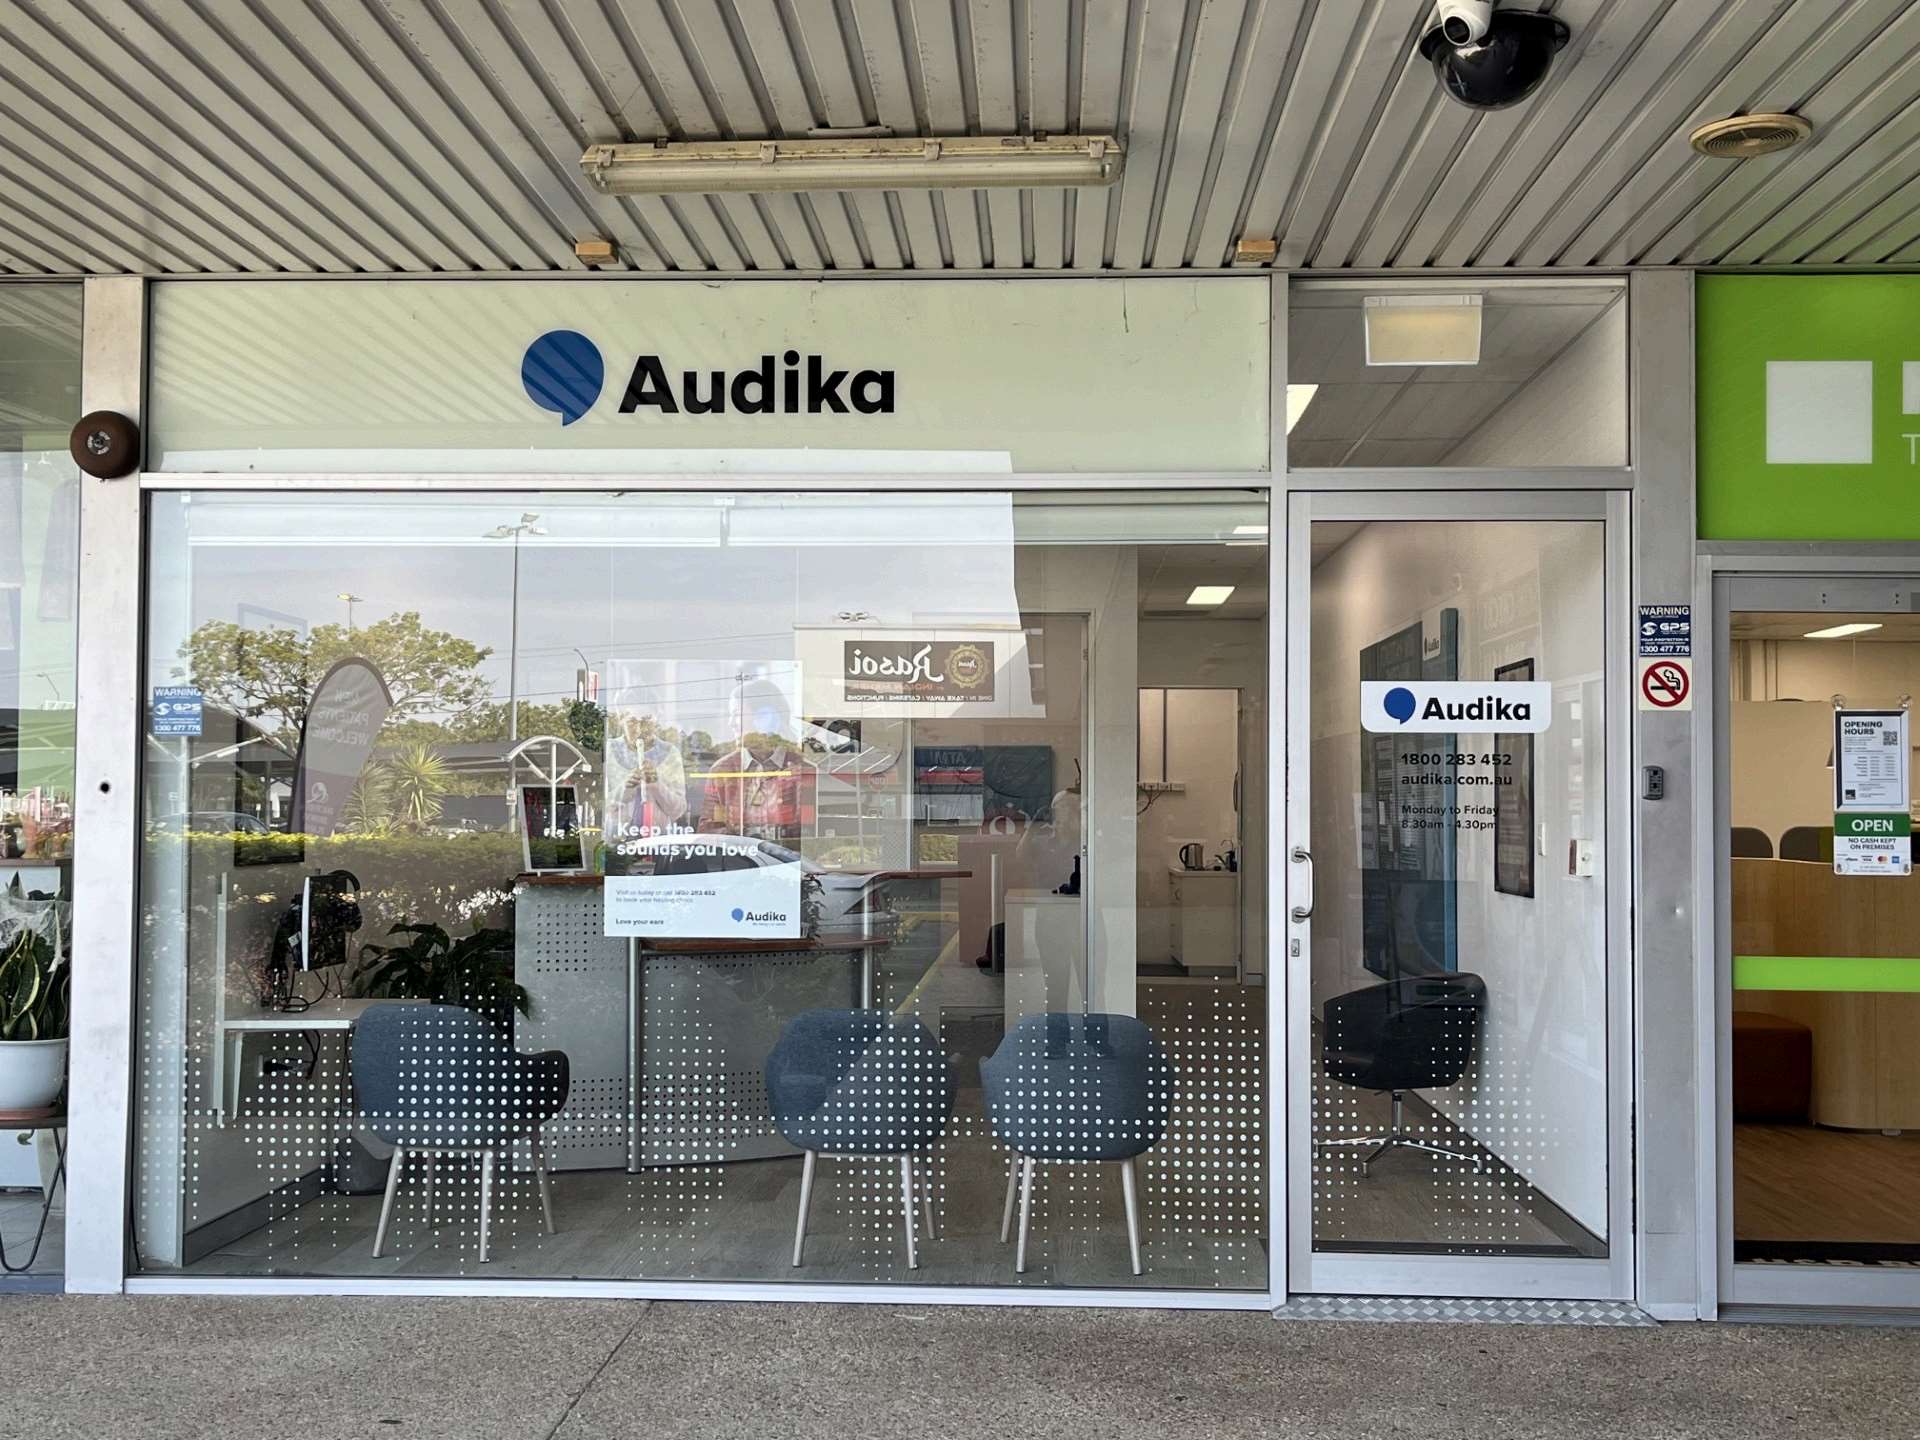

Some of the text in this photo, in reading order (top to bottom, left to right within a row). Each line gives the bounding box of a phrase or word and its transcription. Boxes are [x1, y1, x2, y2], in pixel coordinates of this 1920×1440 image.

[618, 350, 895, 415] Audika
[1640, 606, 1689, 616] WARNING
[1660, 622, 1690, 631] GPS
[155, 687, 201, 696] WARNING
[173, 703, 201, 711] GPS
[1422, 695, 1531, 720] Audika
[1401, 753, 1512, 766] 1800 283 452
[1401, 773, 1513, 785] audika.com.au
[1401, 805, 1499, 816] Monday to Friday
[617, 823, 695, 839] Keep the
[1401, 820, 1444, 829] 8.30am
[1455, 820, 1497, 831] 4.30pm
[1851, 819, 1894, 832] OPEN
[616, 842, 759, 859] sounds you love
[745, 911, 787, 922] Audika
